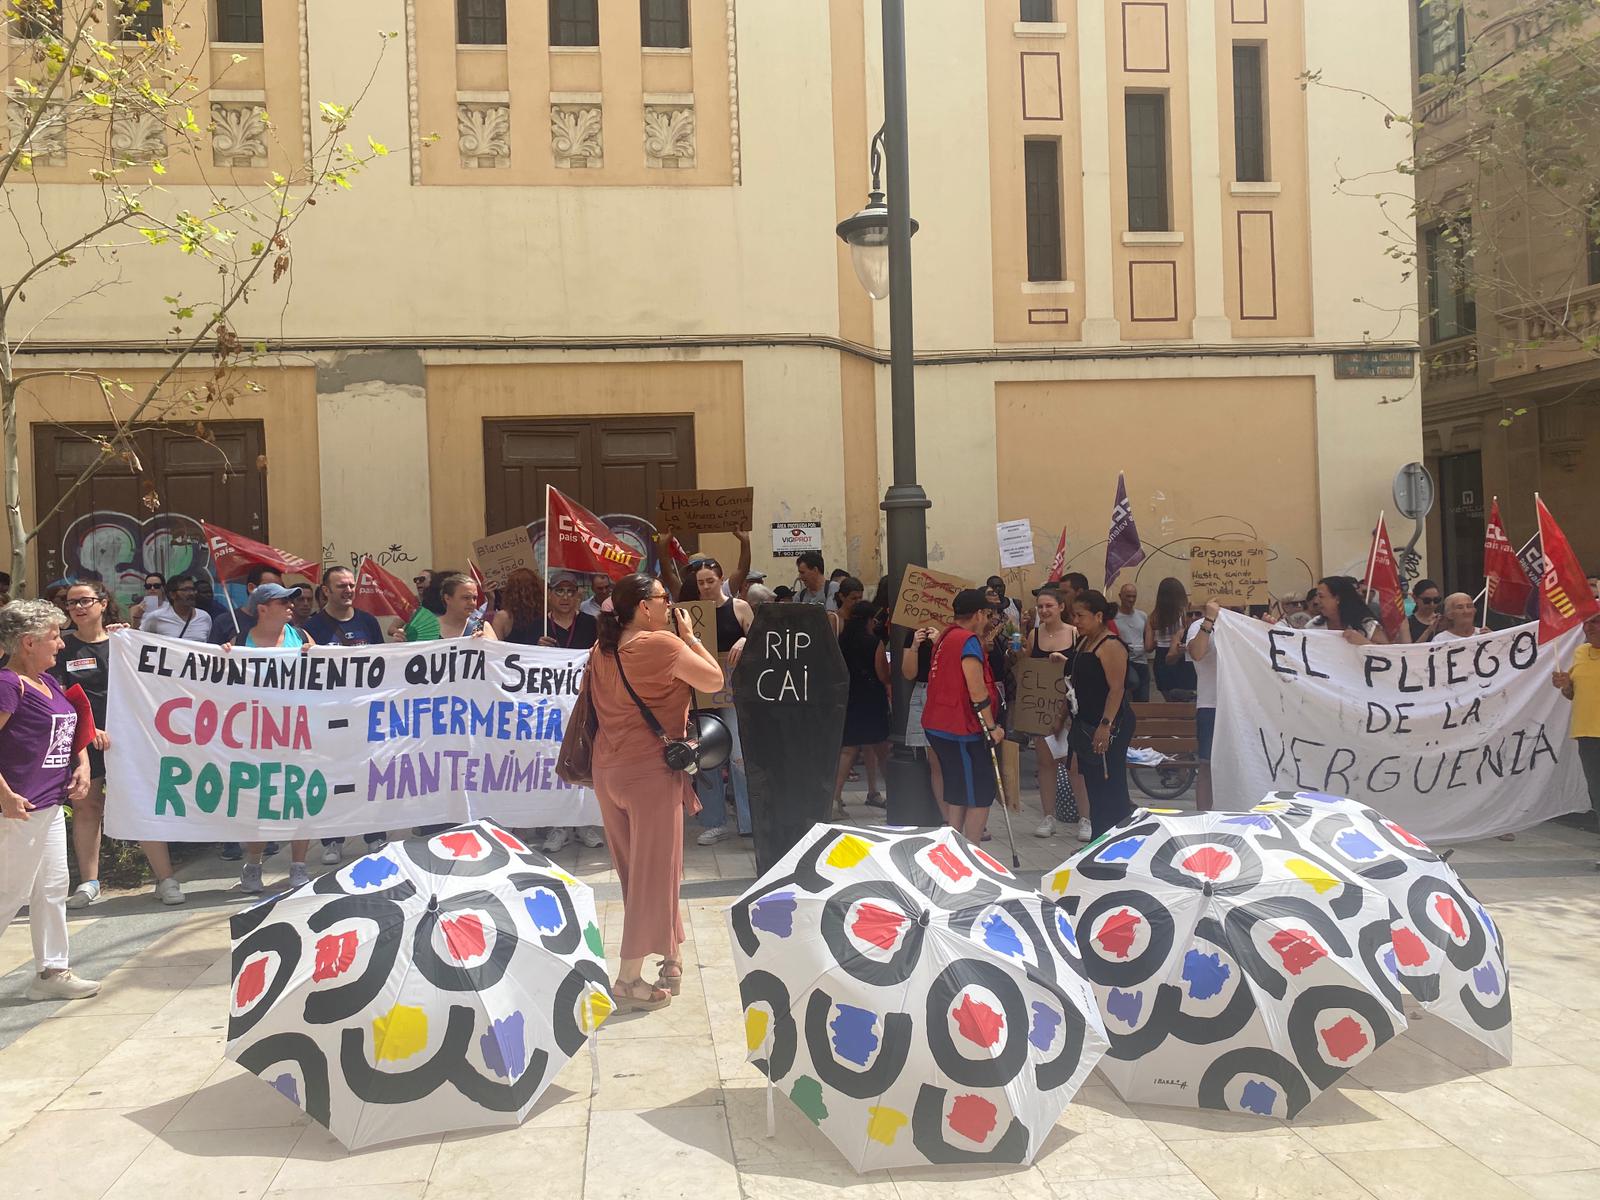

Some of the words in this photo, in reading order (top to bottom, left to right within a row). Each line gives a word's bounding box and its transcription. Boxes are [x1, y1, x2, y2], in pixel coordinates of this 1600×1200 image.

[137, 645, 173, 677] EL
[404, 646, 486, 685] QUITA
[1023, 670, 1047, 690] EL
[1268, 629, 1329, 679] EL
[1364, 631, 1538, 692] PLIEGO
[154, 697, 312, 750] COCINA
[367, 696, 564, 743] ENFERMERÍA
[1366, 701, 1415, 734] DE
[1442, 697, 1481, 730] LA
[1259, 723, 1558, 795] VERGÜENZA
[155, 756, 327, 820] ROPERO
